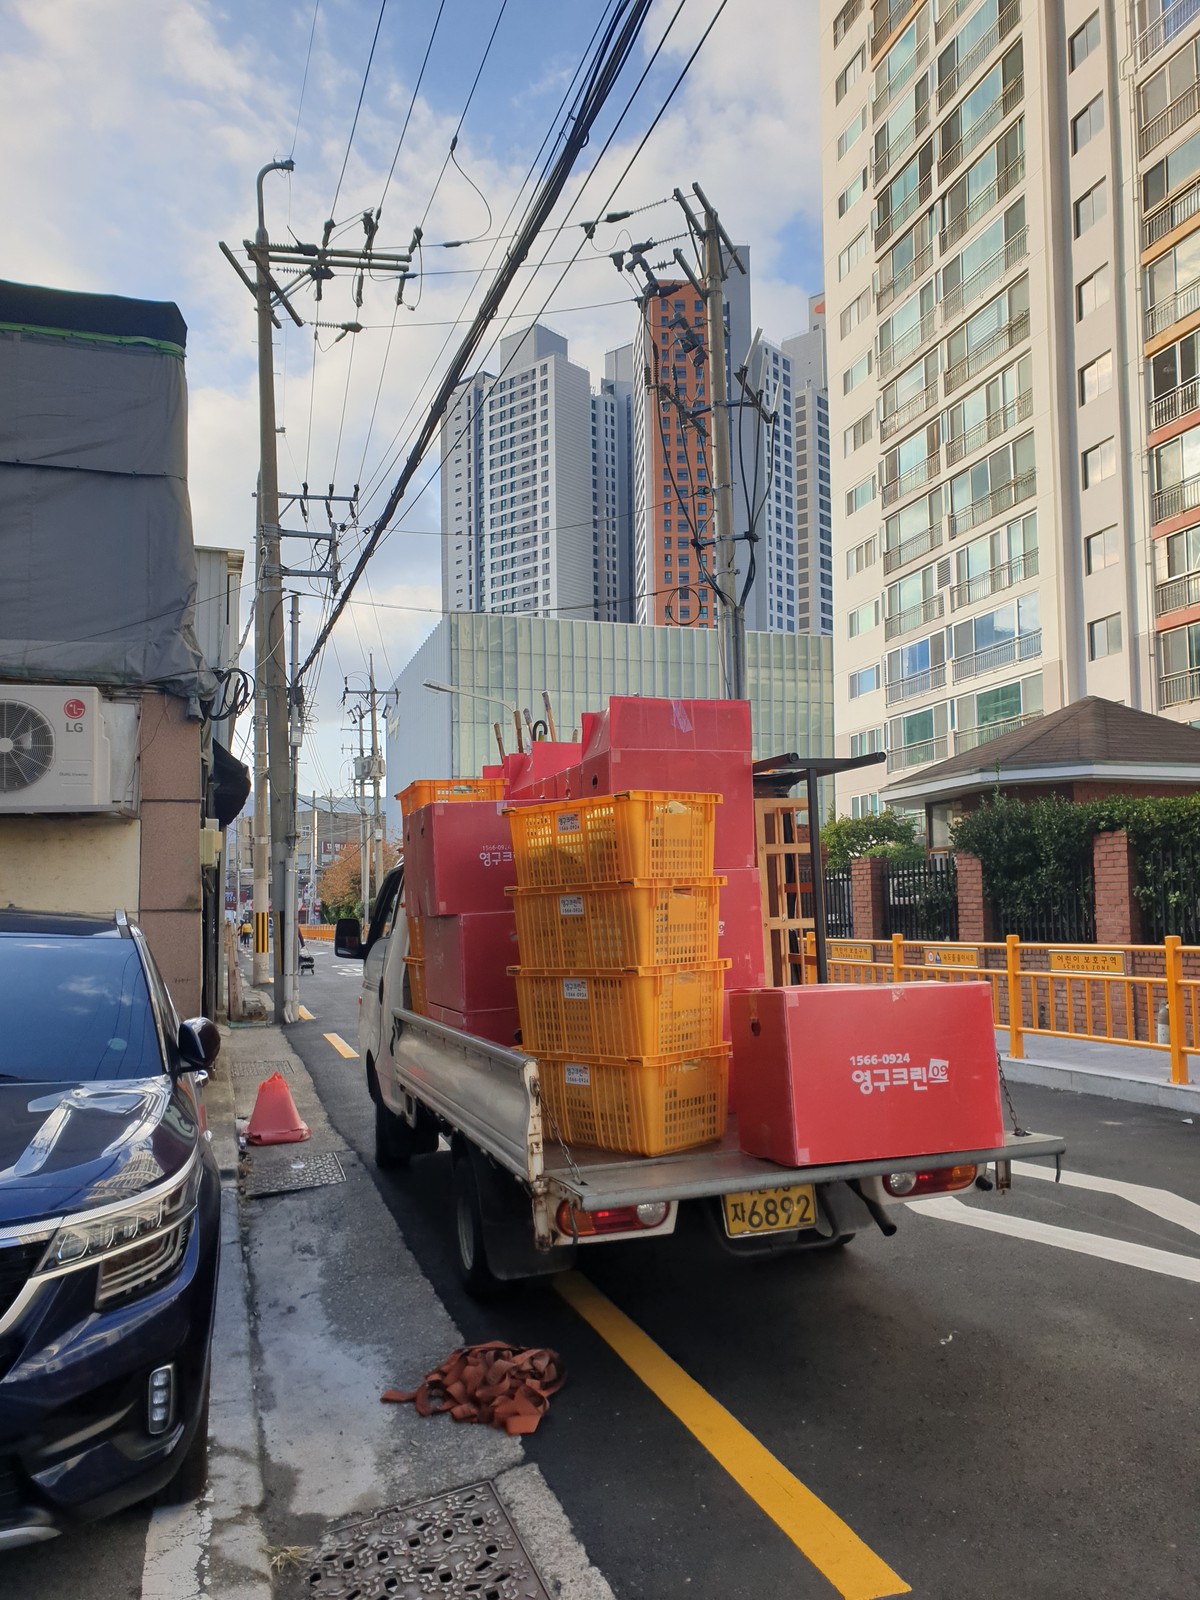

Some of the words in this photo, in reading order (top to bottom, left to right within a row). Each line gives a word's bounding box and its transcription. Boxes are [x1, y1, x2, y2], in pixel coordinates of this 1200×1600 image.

[65, 722, 84, 733] LG
[558, 816, 575, 825] 영구크린
[560, 899, 578, 908] 영구크린
[1057, 955, 1080, 964] 어린이
[1084, 956, 1117, 966] 보호구역
[564, 982, 583, 991] 영구크린
[849, 1052, 911, 1066] 1566-0924
[567, 1066, 584, 1076] 영구크린
[851, 1066, 928, 1095] 영구크린
